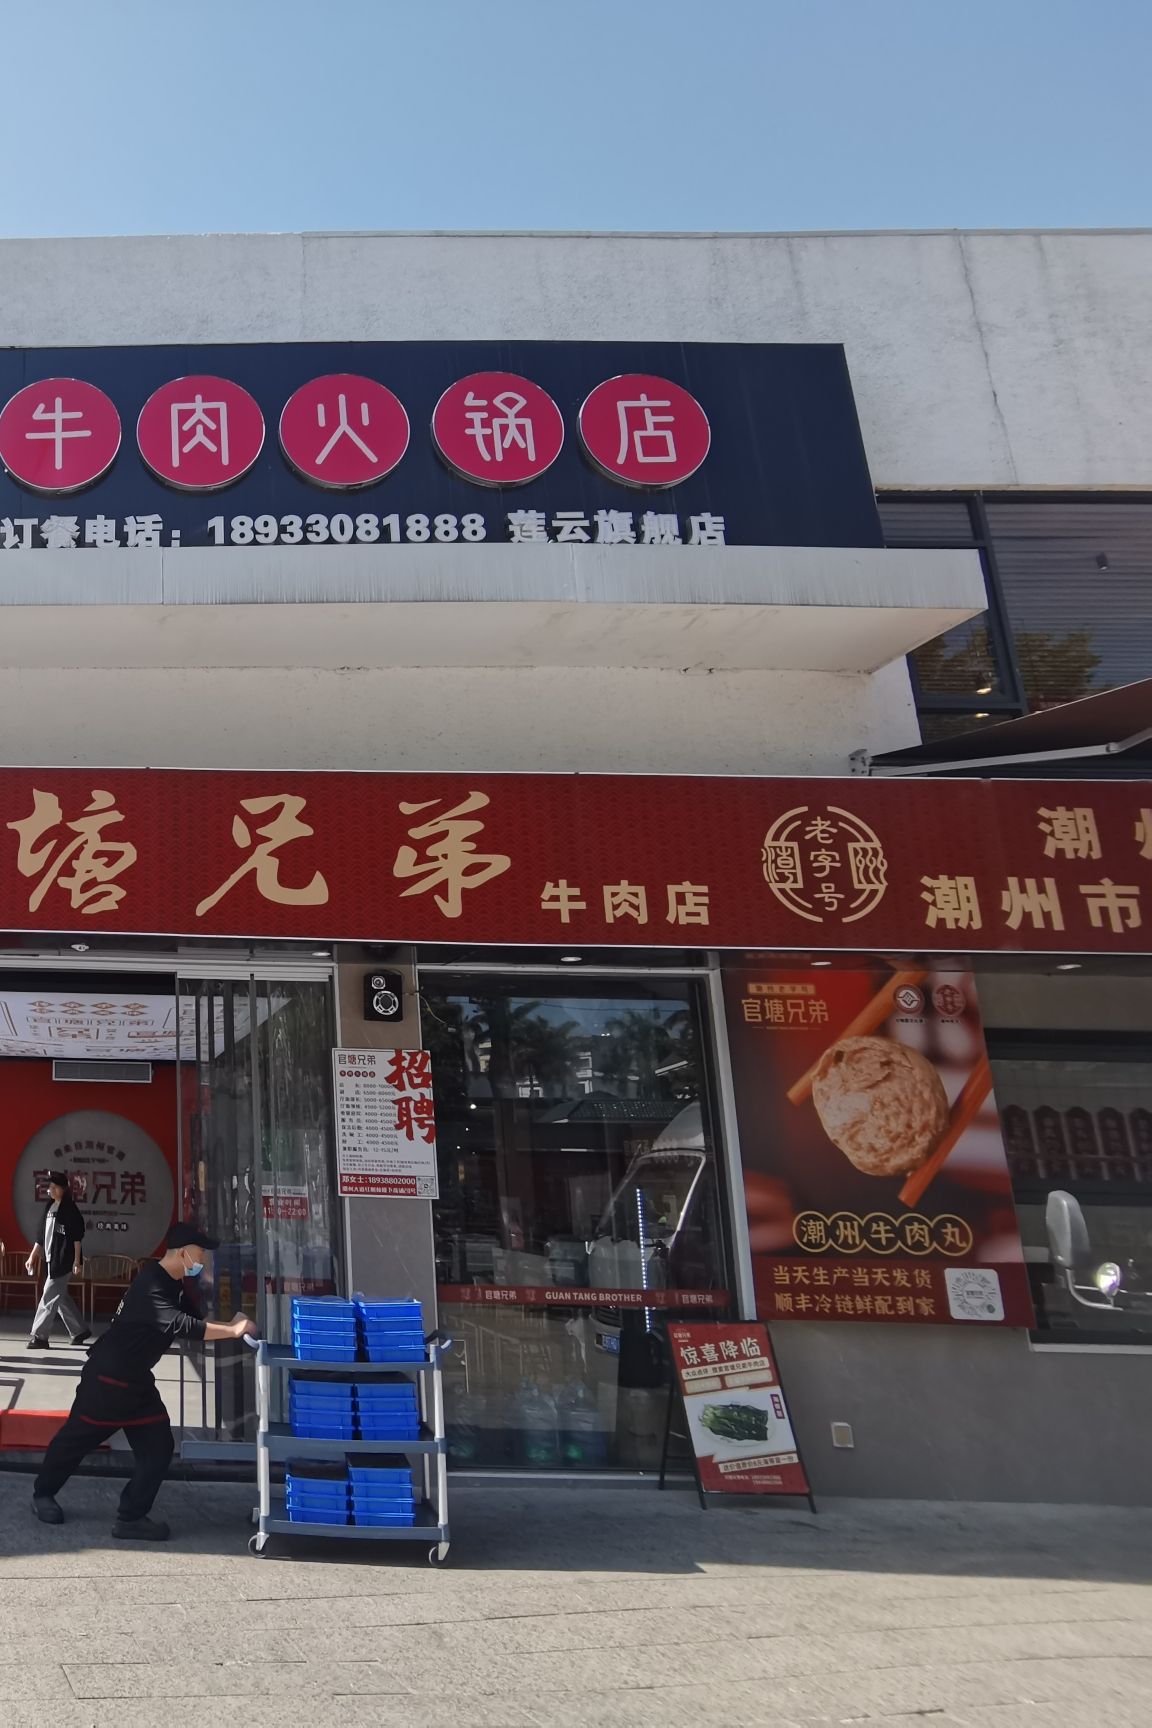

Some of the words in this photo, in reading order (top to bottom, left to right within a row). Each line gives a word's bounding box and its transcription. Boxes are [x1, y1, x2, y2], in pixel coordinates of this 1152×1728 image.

[25, 391, 677, 469] 牛肉火锅店
[207, 514, 486, 546] 18933081888
[505, 509, 727, 546] 莲云旗舰店
[1037, 806, 1152, 860] 潮
[804, 816, 845, 911] 老字号
[540, 879, 710, 926] 牛肉店
[920, 874, 1142, 933] 潮州市
[742, 998, 829, 1024] 官塘兄弟
[384, 1048, 436, 1144] 招聘
[800, 1219, 968, 1249] 潮州牛肉丸
[773, 1265, 934, 1288] 当天生产当天发货
[545, 1291, 571, 1300] GUAN
[572, 1292, 597, 1301] TANG
[599, 1292, 642, 1302] BROTHER
[775, 1292, 936, 1316] 顺丰冷链鲜配到家
[680, 1337, 761, 1365] 惊喜降临
